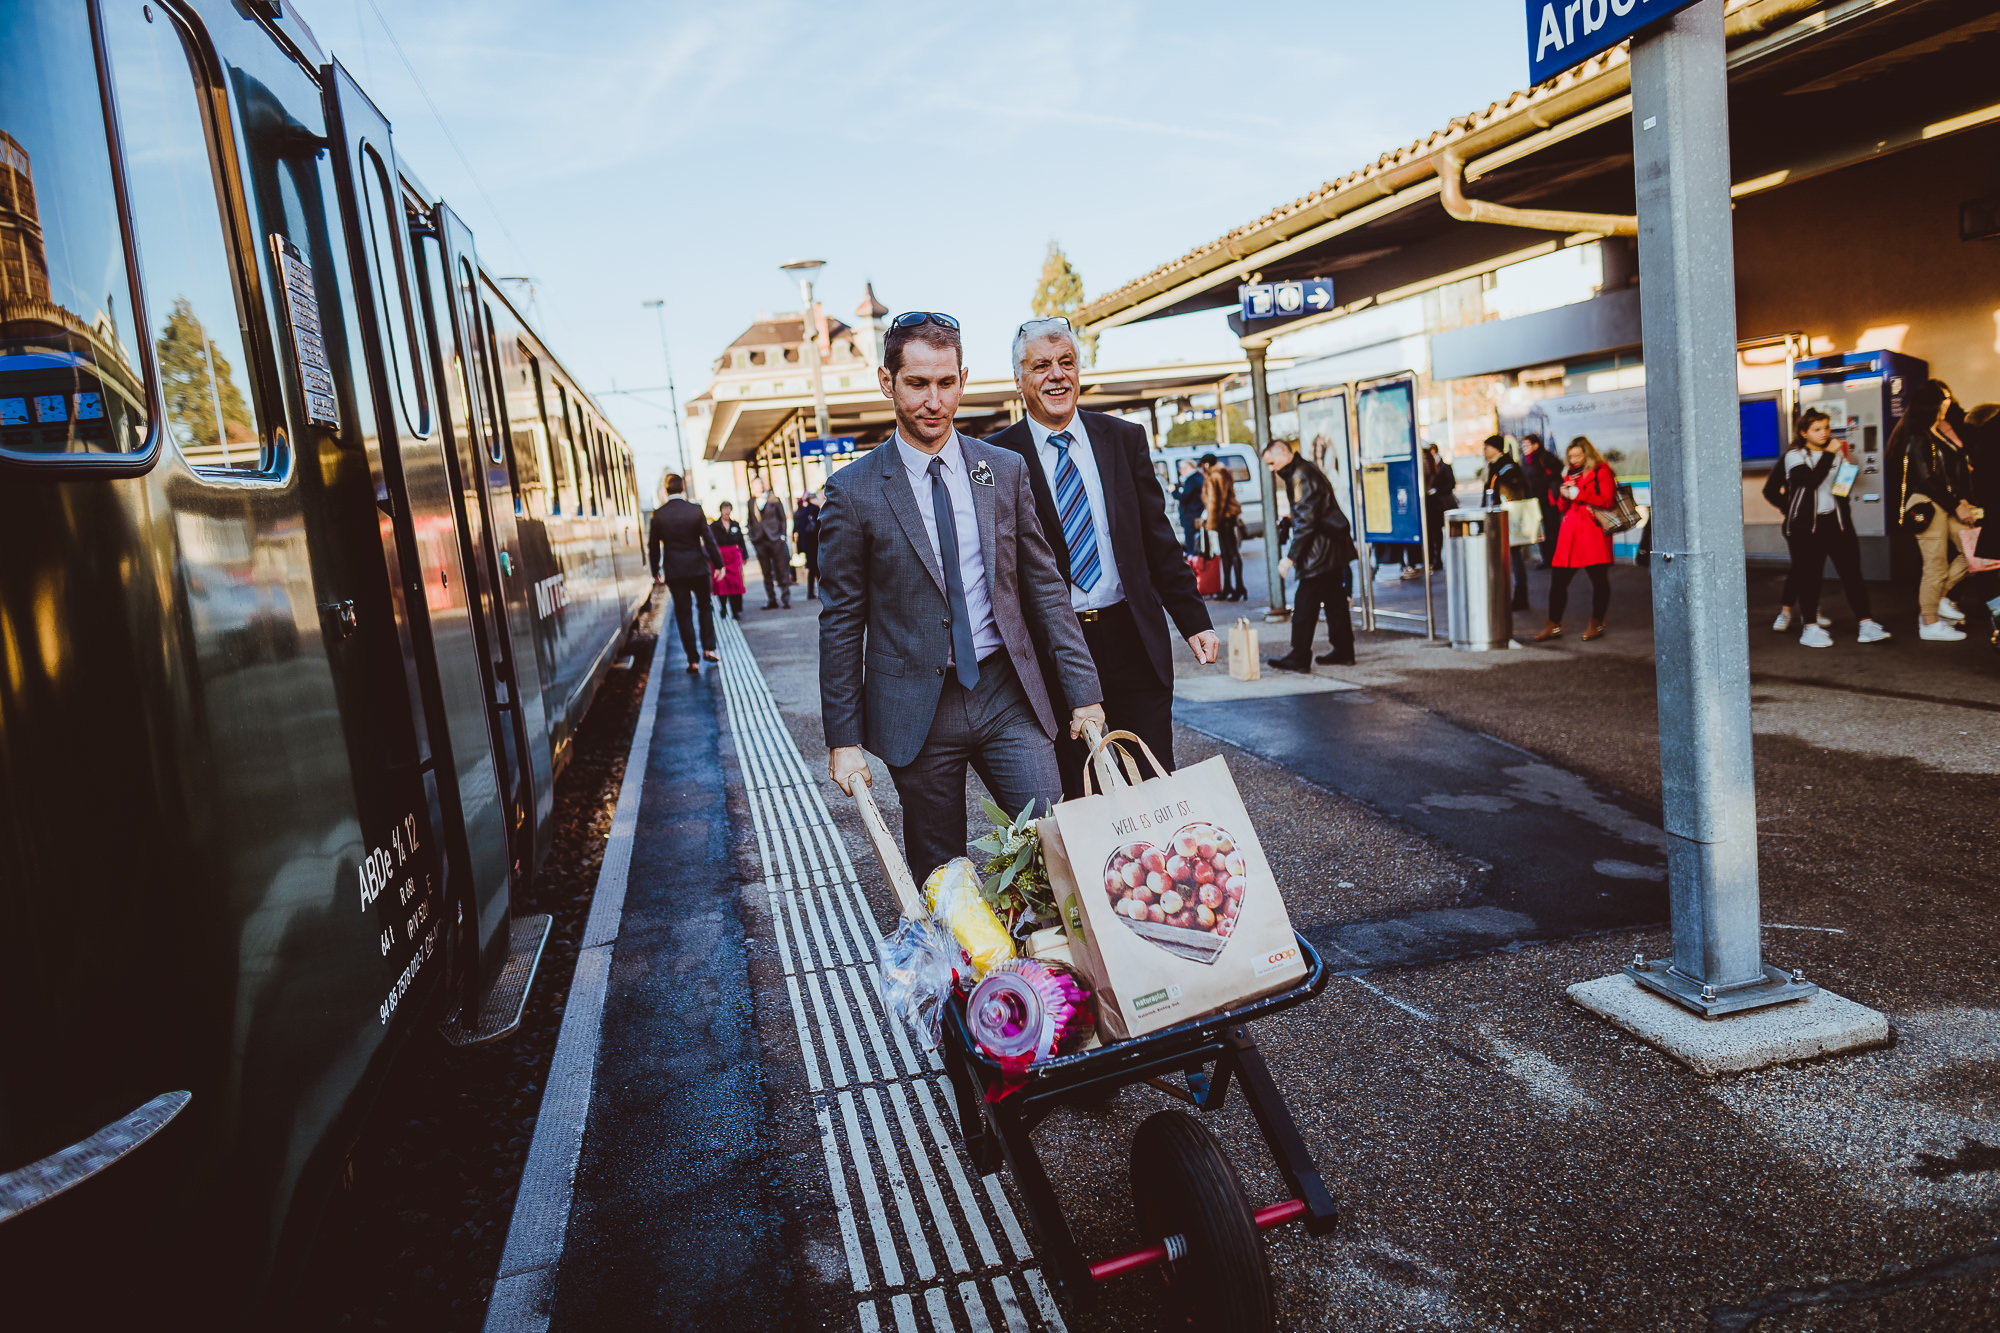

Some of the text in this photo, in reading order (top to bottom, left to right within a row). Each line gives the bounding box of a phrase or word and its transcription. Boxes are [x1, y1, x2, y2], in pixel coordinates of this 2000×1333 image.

[1112, 816, 1139, 836] WEIL
[1139, 813, 1151, 829] ES
[1154, 805, 1174, 824] GUT
[359, 846, 394, 913] ABDe
[405, 813, 420, 854] 12
[1268, 948, 1296, 964] coop
[380, 999, 390, 1025] 94
[388, 986, 398, 1012] 85
